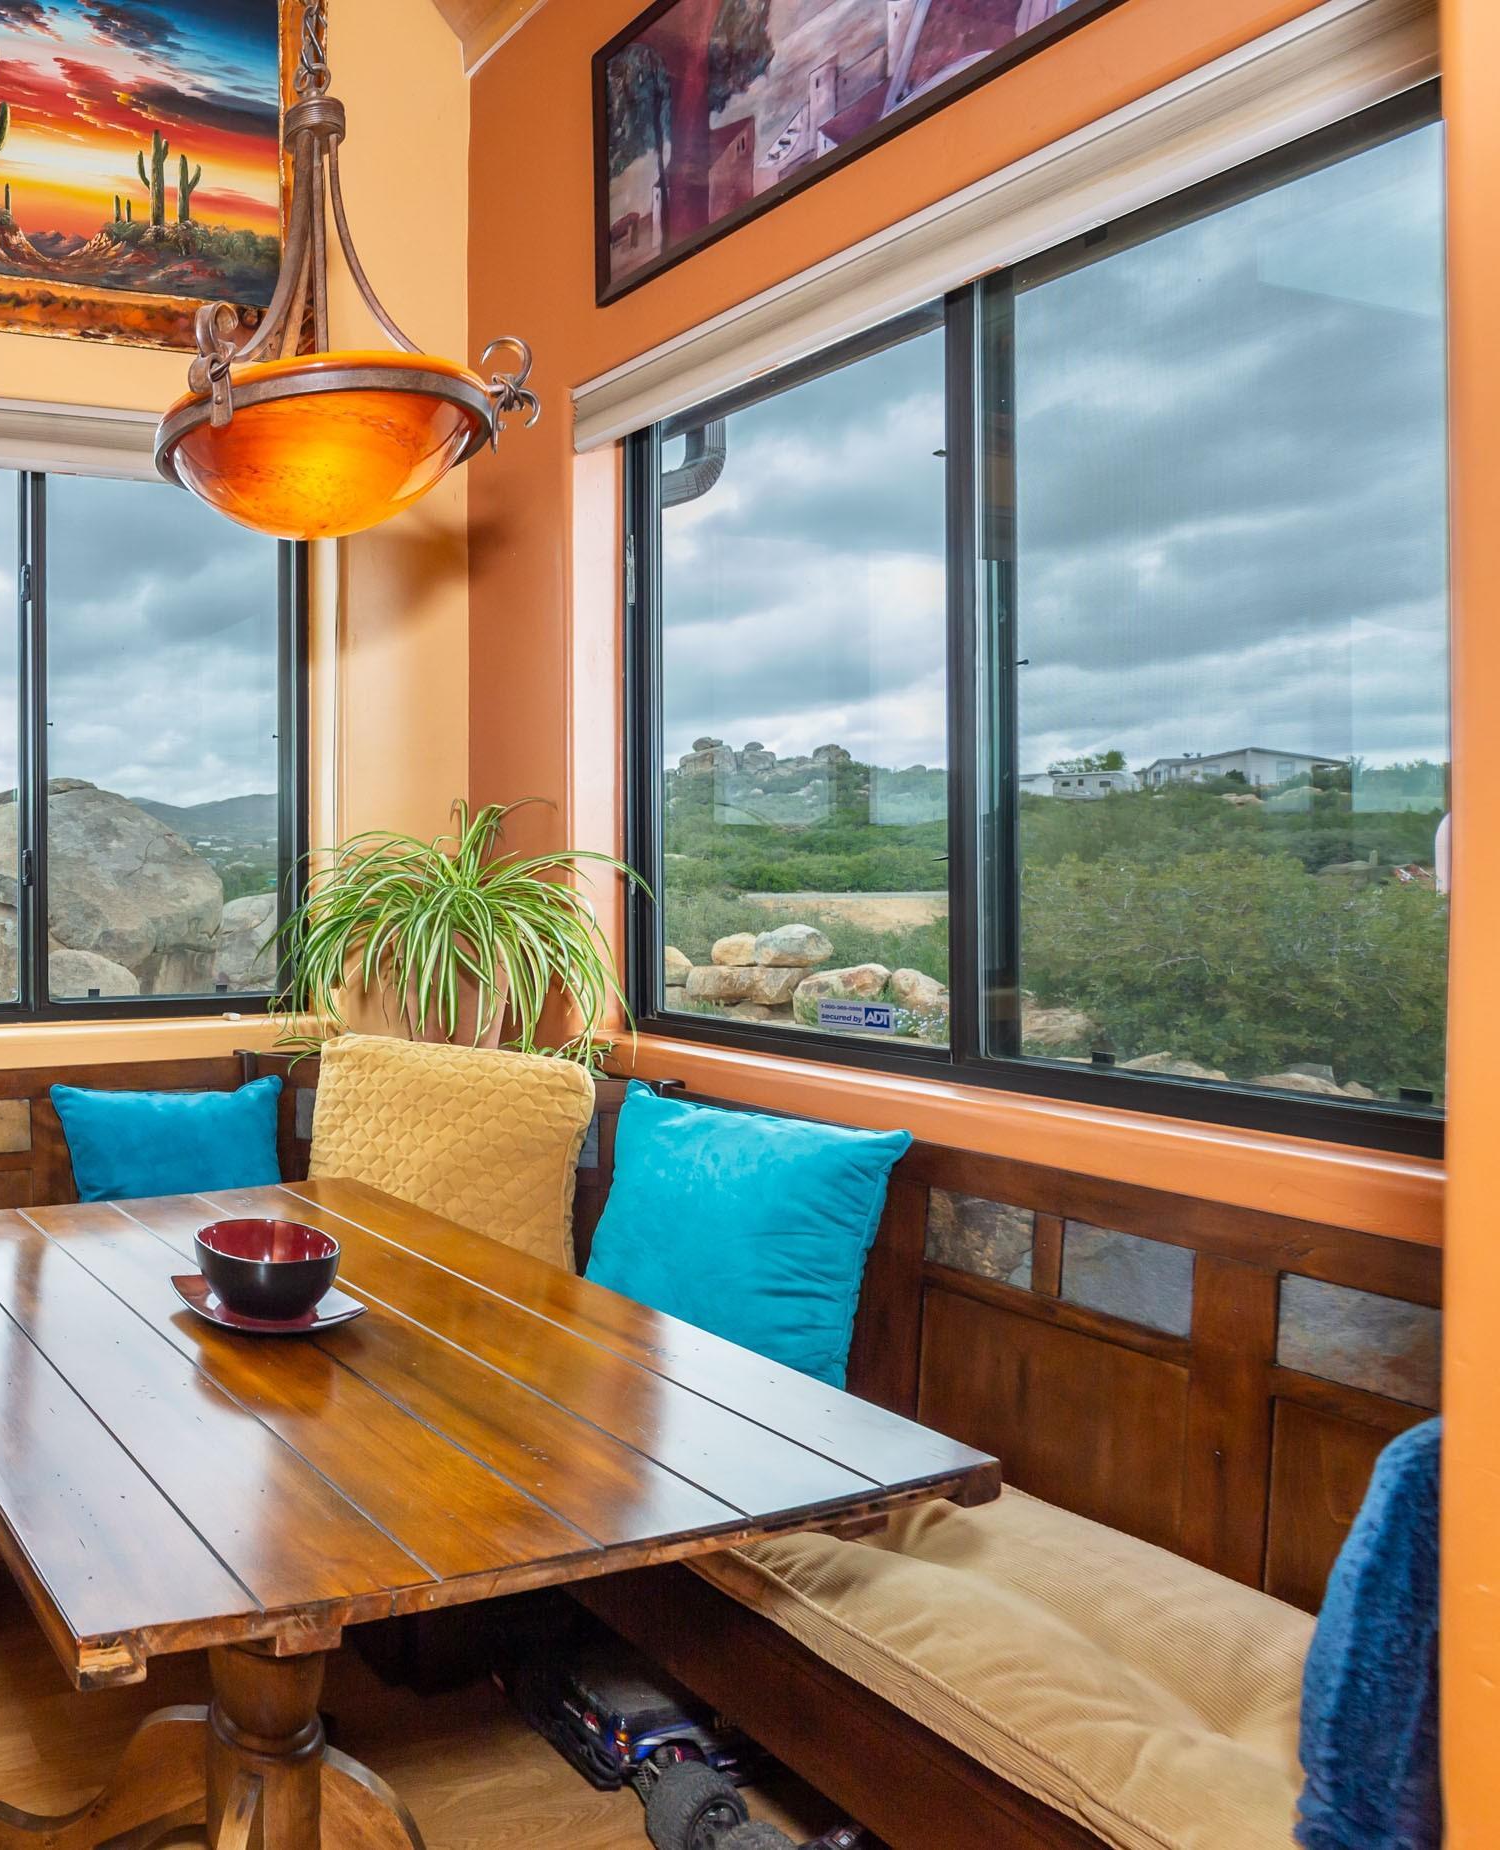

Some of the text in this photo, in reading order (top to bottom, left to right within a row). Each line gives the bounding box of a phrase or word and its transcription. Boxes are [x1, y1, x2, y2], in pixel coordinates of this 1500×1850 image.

[821, 1013, 862, 1023] secured by
[865, 1010, 890, 1025] ADT
